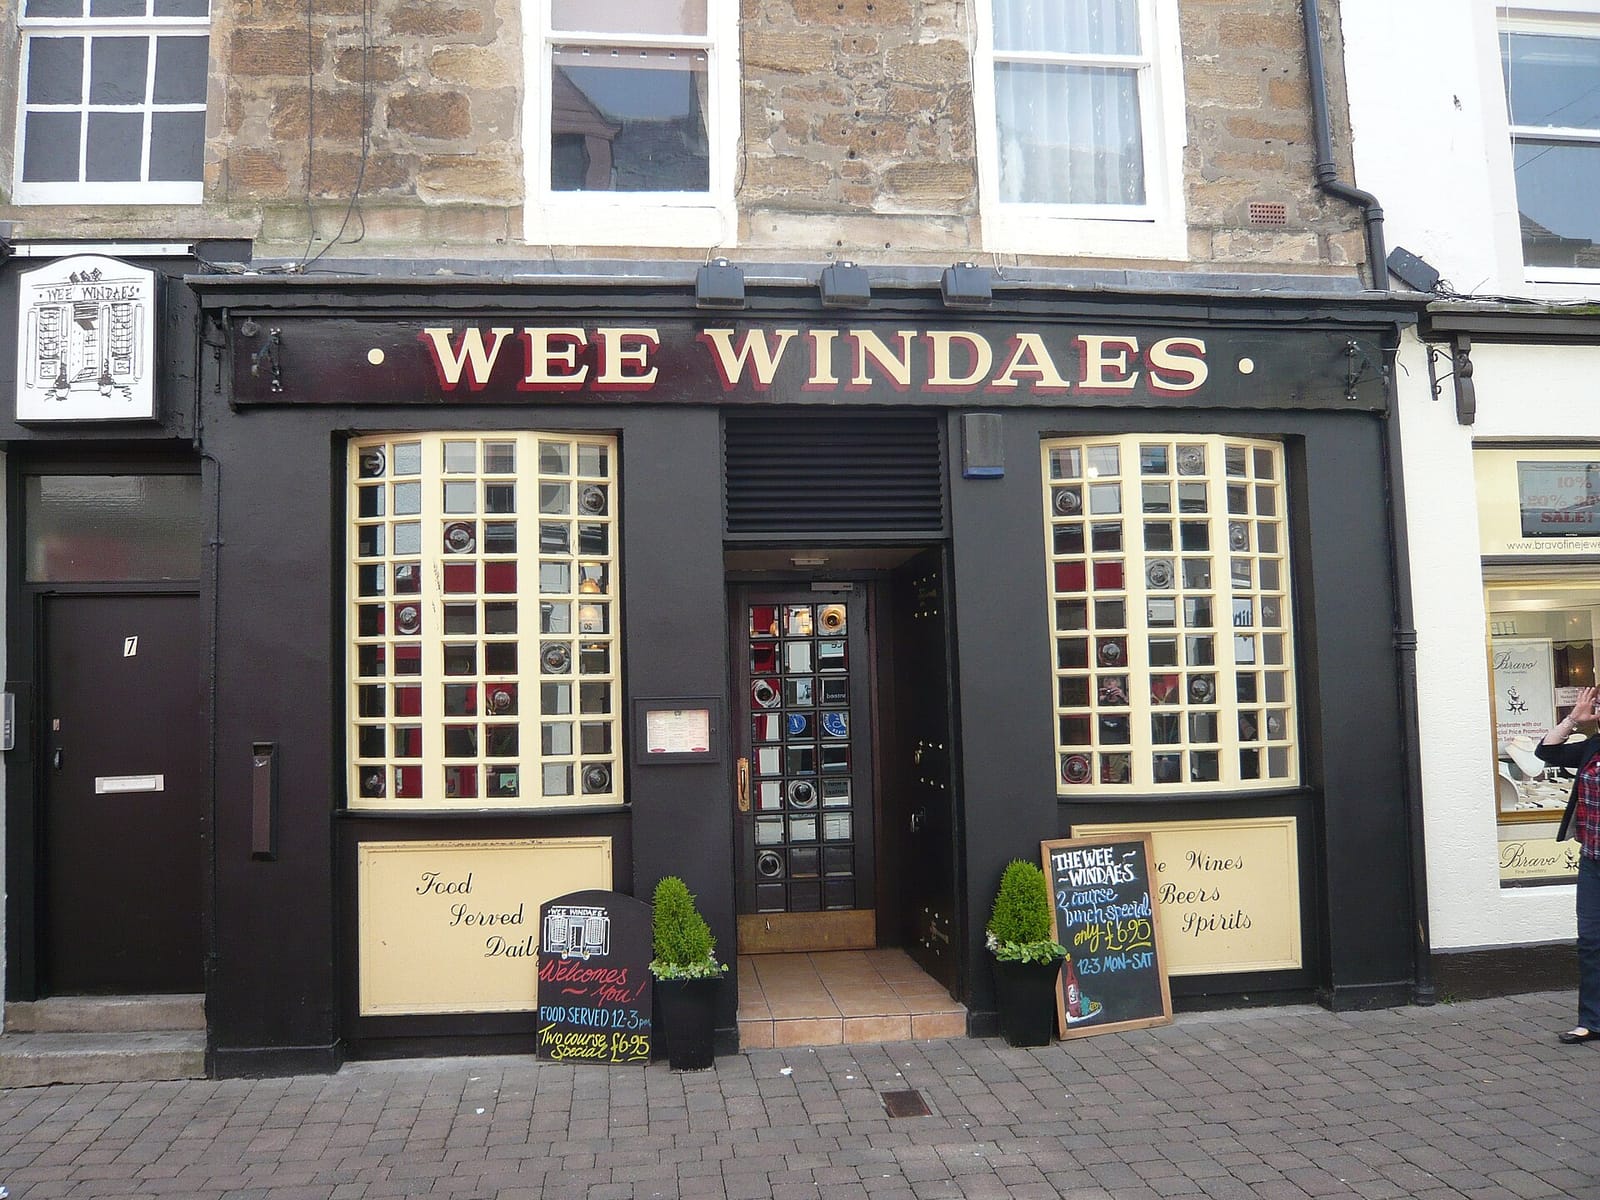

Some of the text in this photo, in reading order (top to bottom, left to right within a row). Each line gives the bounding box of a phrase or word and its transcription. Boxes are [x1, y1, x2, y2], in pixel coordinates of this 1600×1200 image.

[46, 285, 135, 301] WEE WINDAES
[419, 327, 1209, 396] WEE WINDAES
[1557, 476, 1592, 489] 10%
[1541, 511, 1593, 523] SALE!
[127, 638, 136, 655] 7
[1492, 651, 1538, 670] Bravo
[1052, 847, 1114, 871] THE WEE
[1186, 850, 1243, 872] Wines
[1500, 842, 1561, 869] Bravo
[416, 872, 472, 895] Food
[1068, 863, 1135, 887] WINDAES
[1056, 888, 1118, 908] 2 course
[1159, 882, 1220, 905] Beers
[449, 903, 524, 926] Served
[1064, 892, 1152, 929] lunch special
[1182, 909, 1251, 937] Spirits
[1074, 921, 1105, 952] only
[538, 959, 628, 985] Welcomes
[1077, 952, 1153, 975] 12-3 MON-SAT
[590, 981, 646, 1007] You!
[540, 1006, 566, 1021] FOOD
[567, 1007, 609, 1028] SERVED
[538, 1023, 607, 1048] Two course
